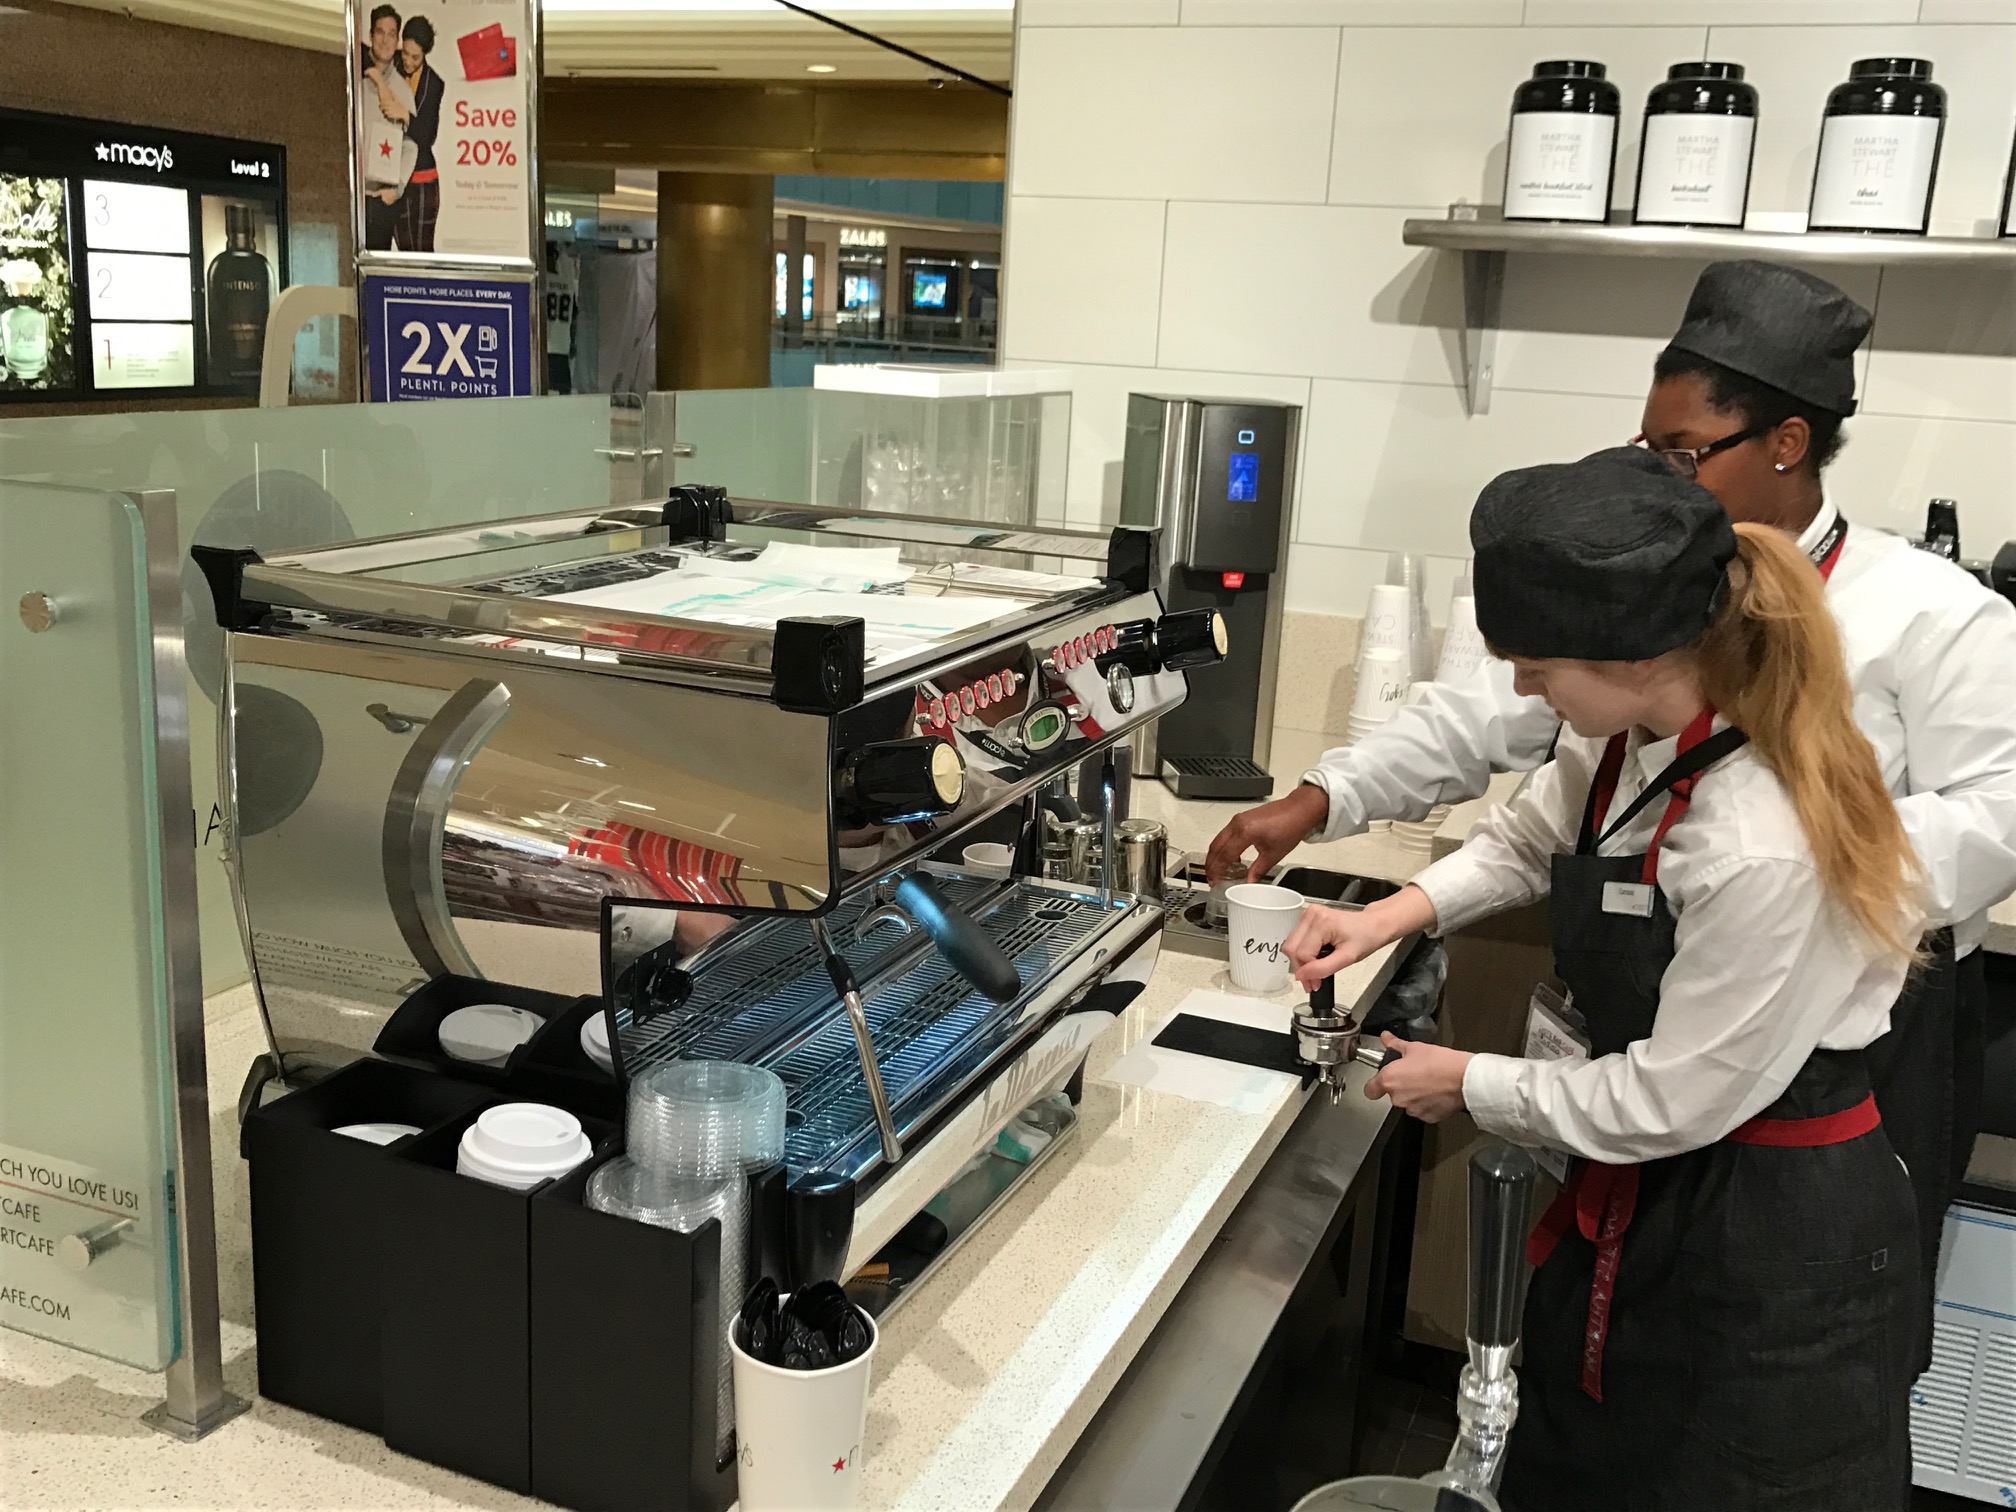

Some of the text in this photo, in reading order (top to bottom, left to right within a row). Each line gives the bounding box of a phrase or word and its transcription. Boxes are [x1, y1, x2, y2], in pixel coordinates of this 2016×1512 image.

[455, 100, 517, 128] Save
[110, 143, 174, 173] macy's
[456, 140, 518, 167] 20%
[231, 159, 271, 178] Level 2
[94, 194, 110, 226] 3
[840, 228, 888, 248] ZALES
[97, 267, 112, 299] 2
[401, 320, 476, 378] 2X
[451, 381, 498, 396] POINTS
[1243, 937, 1281, 963] enj
[0, 1158, 23, 1180] CH
[27, 1164, 63, 1190] YOU
[68, 1175, 108, 1203] LOVE
[112, 1187, 139, 1211] US!
